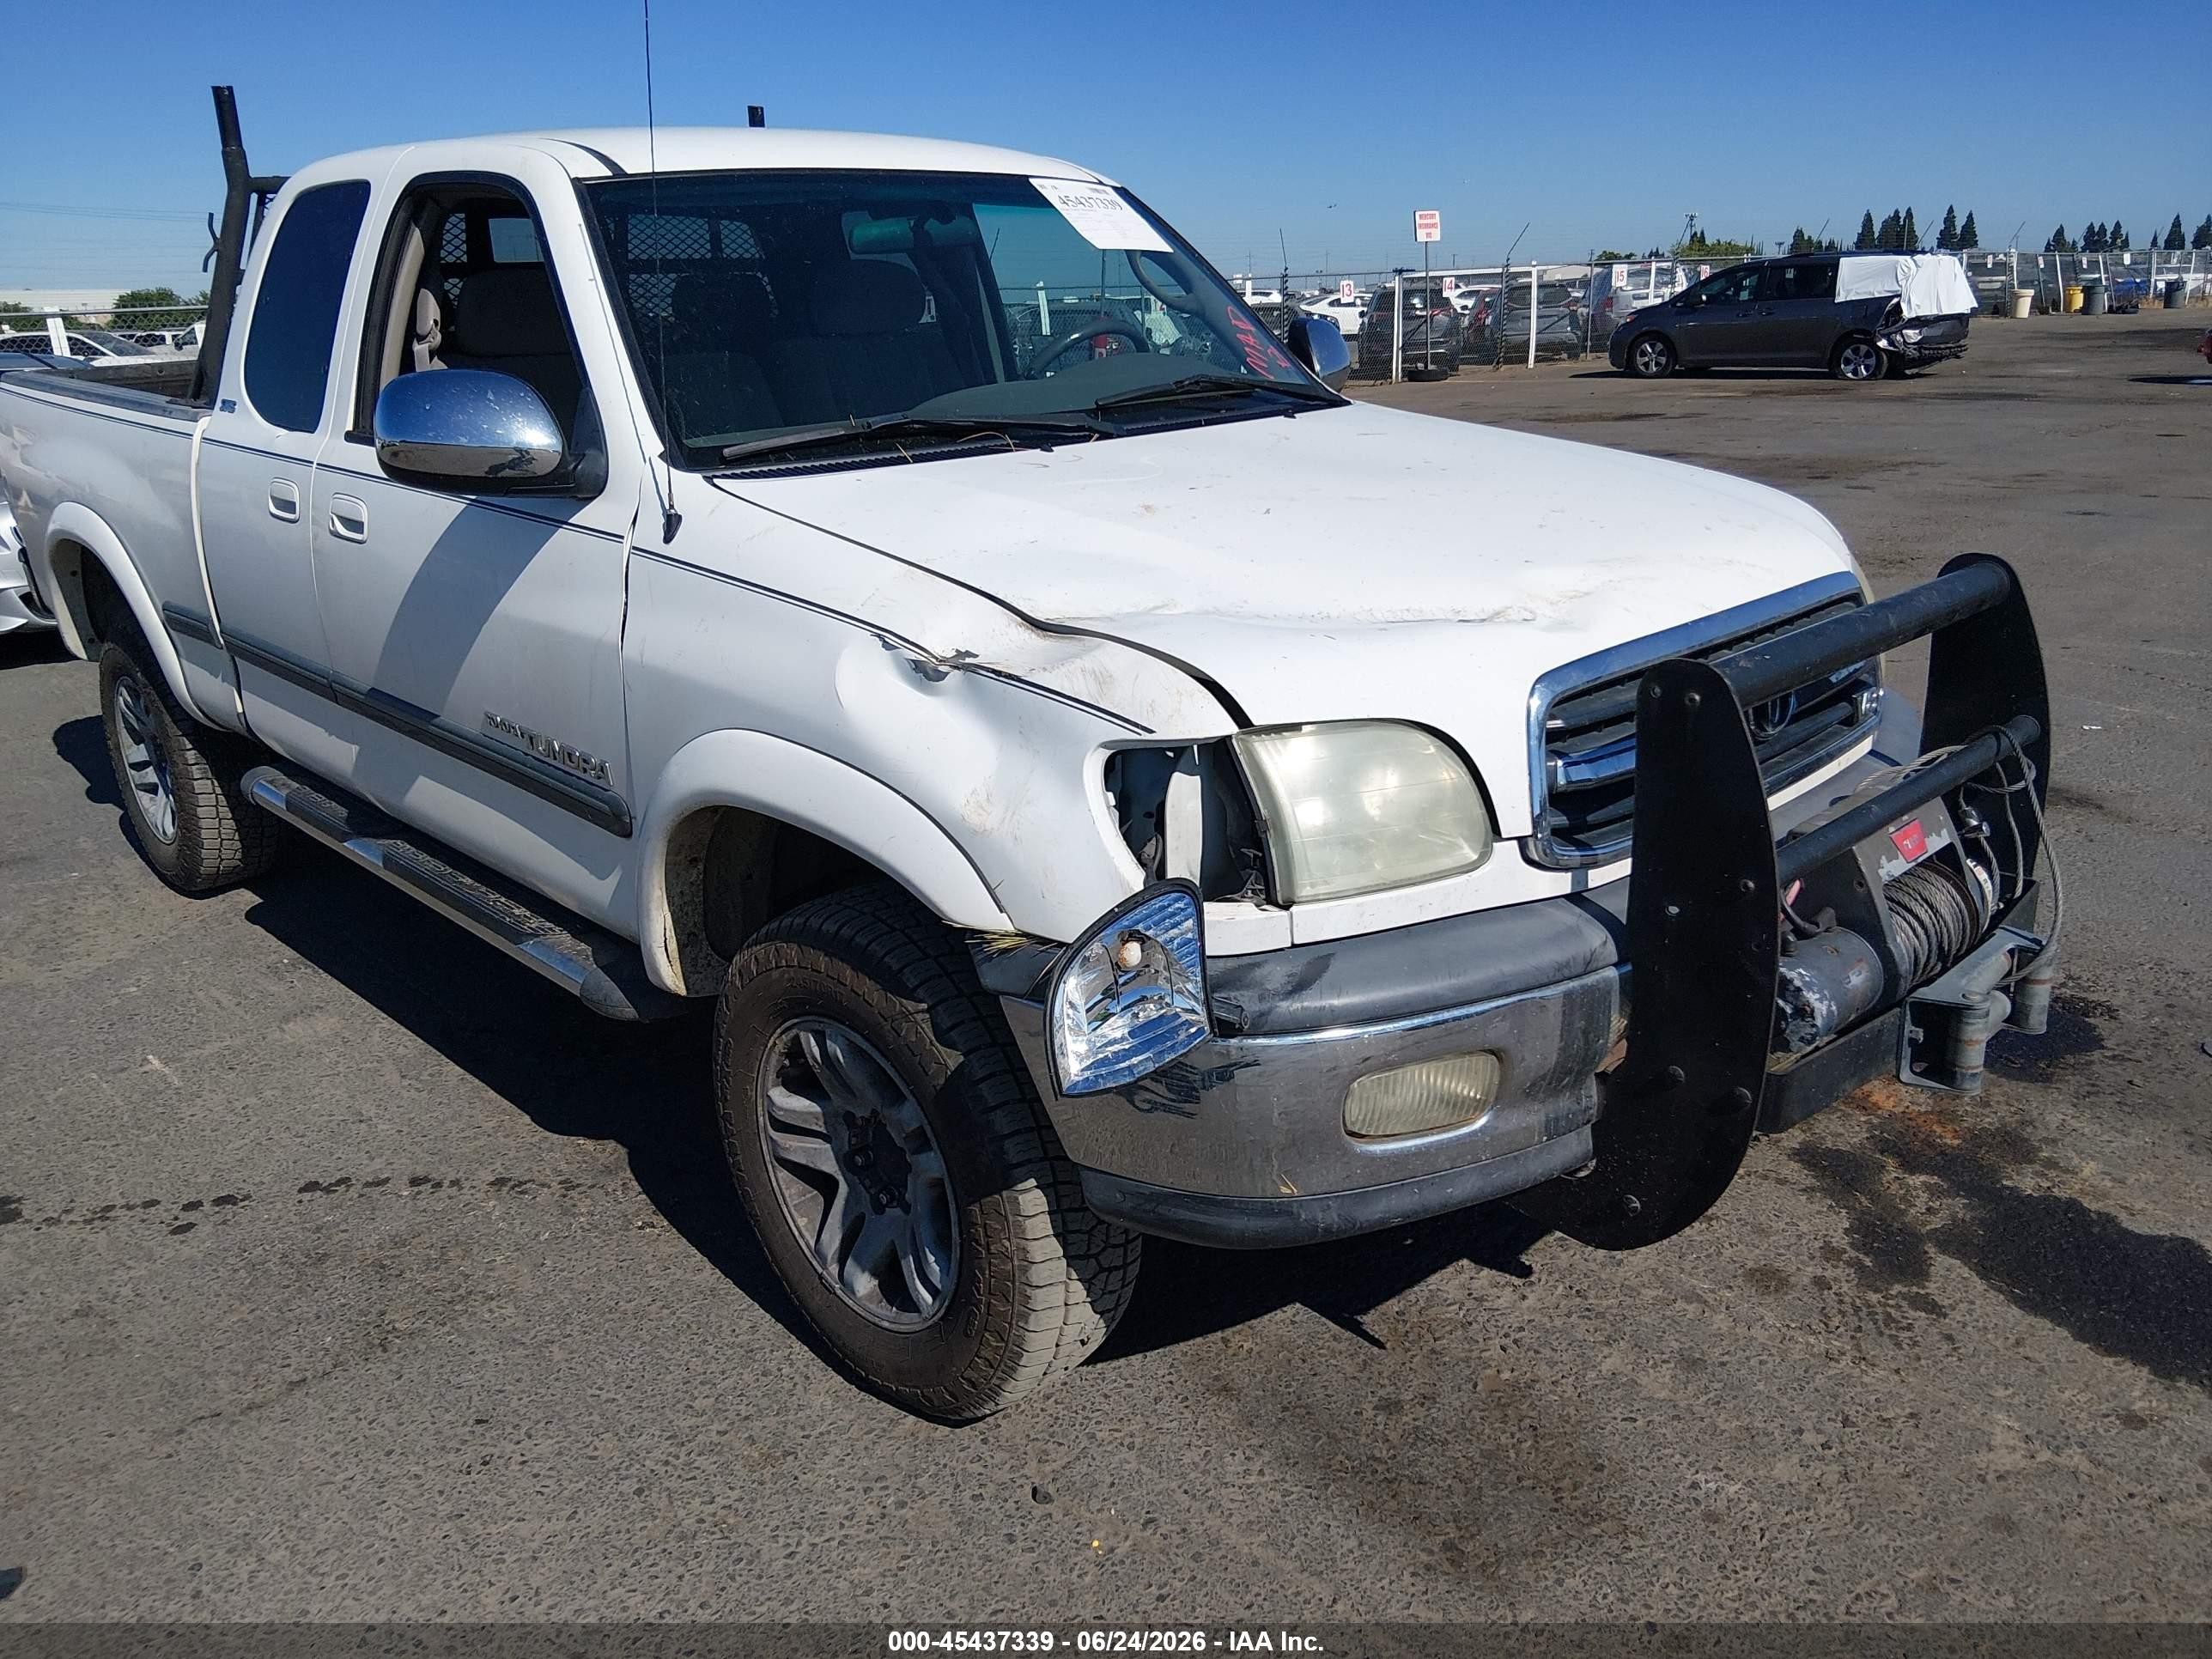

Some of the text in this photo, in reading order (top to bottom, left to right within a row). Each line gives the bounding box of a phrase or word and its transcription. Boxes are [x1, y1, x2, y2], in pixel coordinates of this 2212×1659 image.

[1057, 195, 1123, 211] 45437339
[1615, 270, 1626, 283] 15
[1700, 266, 1710, 278] 16
[1341, 283, 1352, 298] 13
[1443, 279, 1454, 293] 14
[527, 731, 614, 787] TUNDRA
